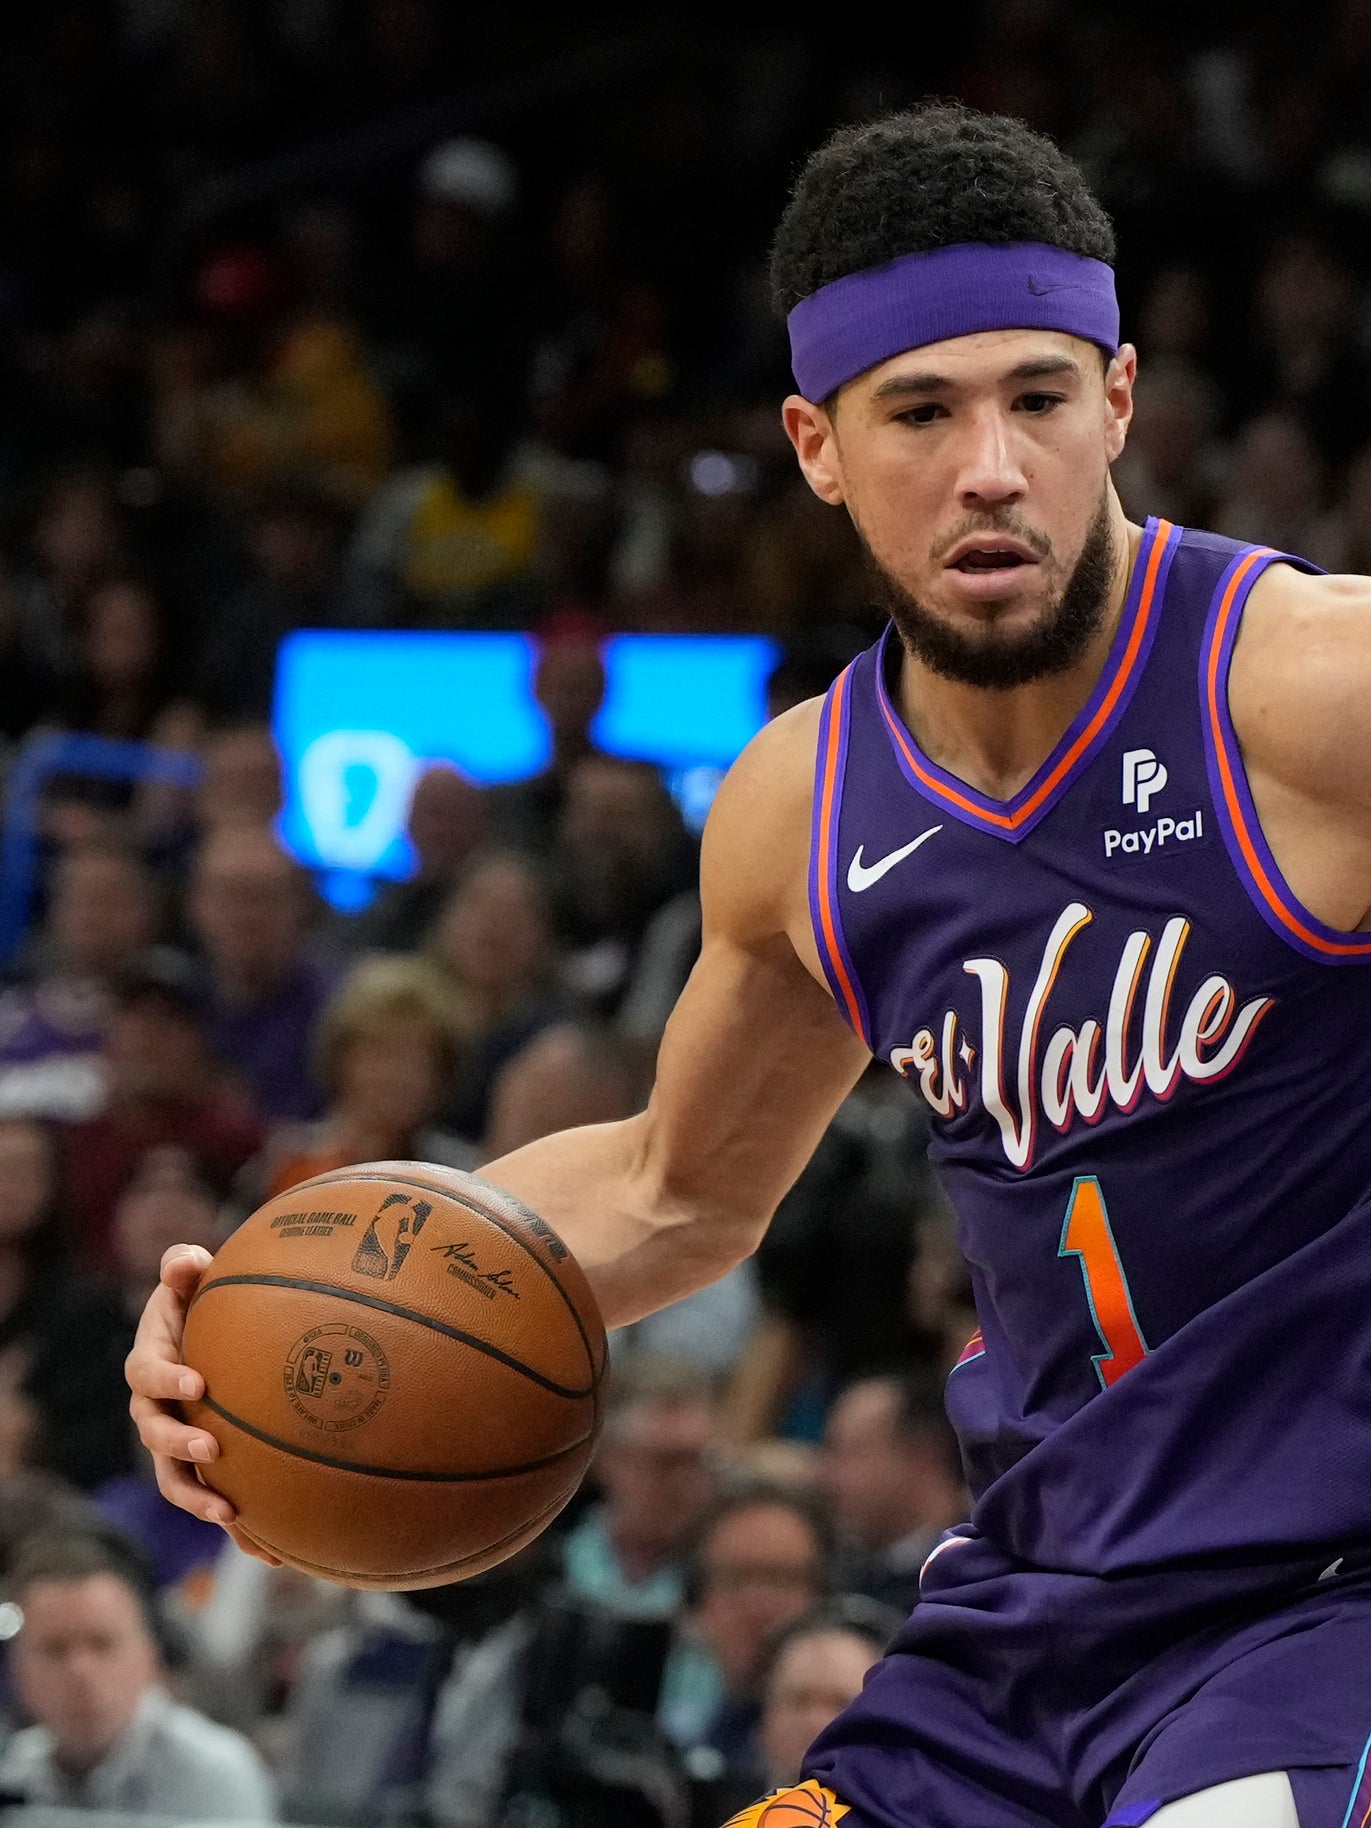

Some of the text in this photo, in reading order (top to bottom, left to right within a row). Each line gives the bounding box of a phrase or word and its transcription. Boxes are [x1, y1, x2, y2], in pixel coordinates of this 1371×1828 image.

[1104, 810, 1203, 858] PayPal
[890, 902, 1277, 1172] El Valle
[271, 1211, 357, 1229] OFFICIAL GAME BALL
[446, 1263, 497, 1300] COMMISSIONER
[1057, 1174, 1154, 1393] 1
